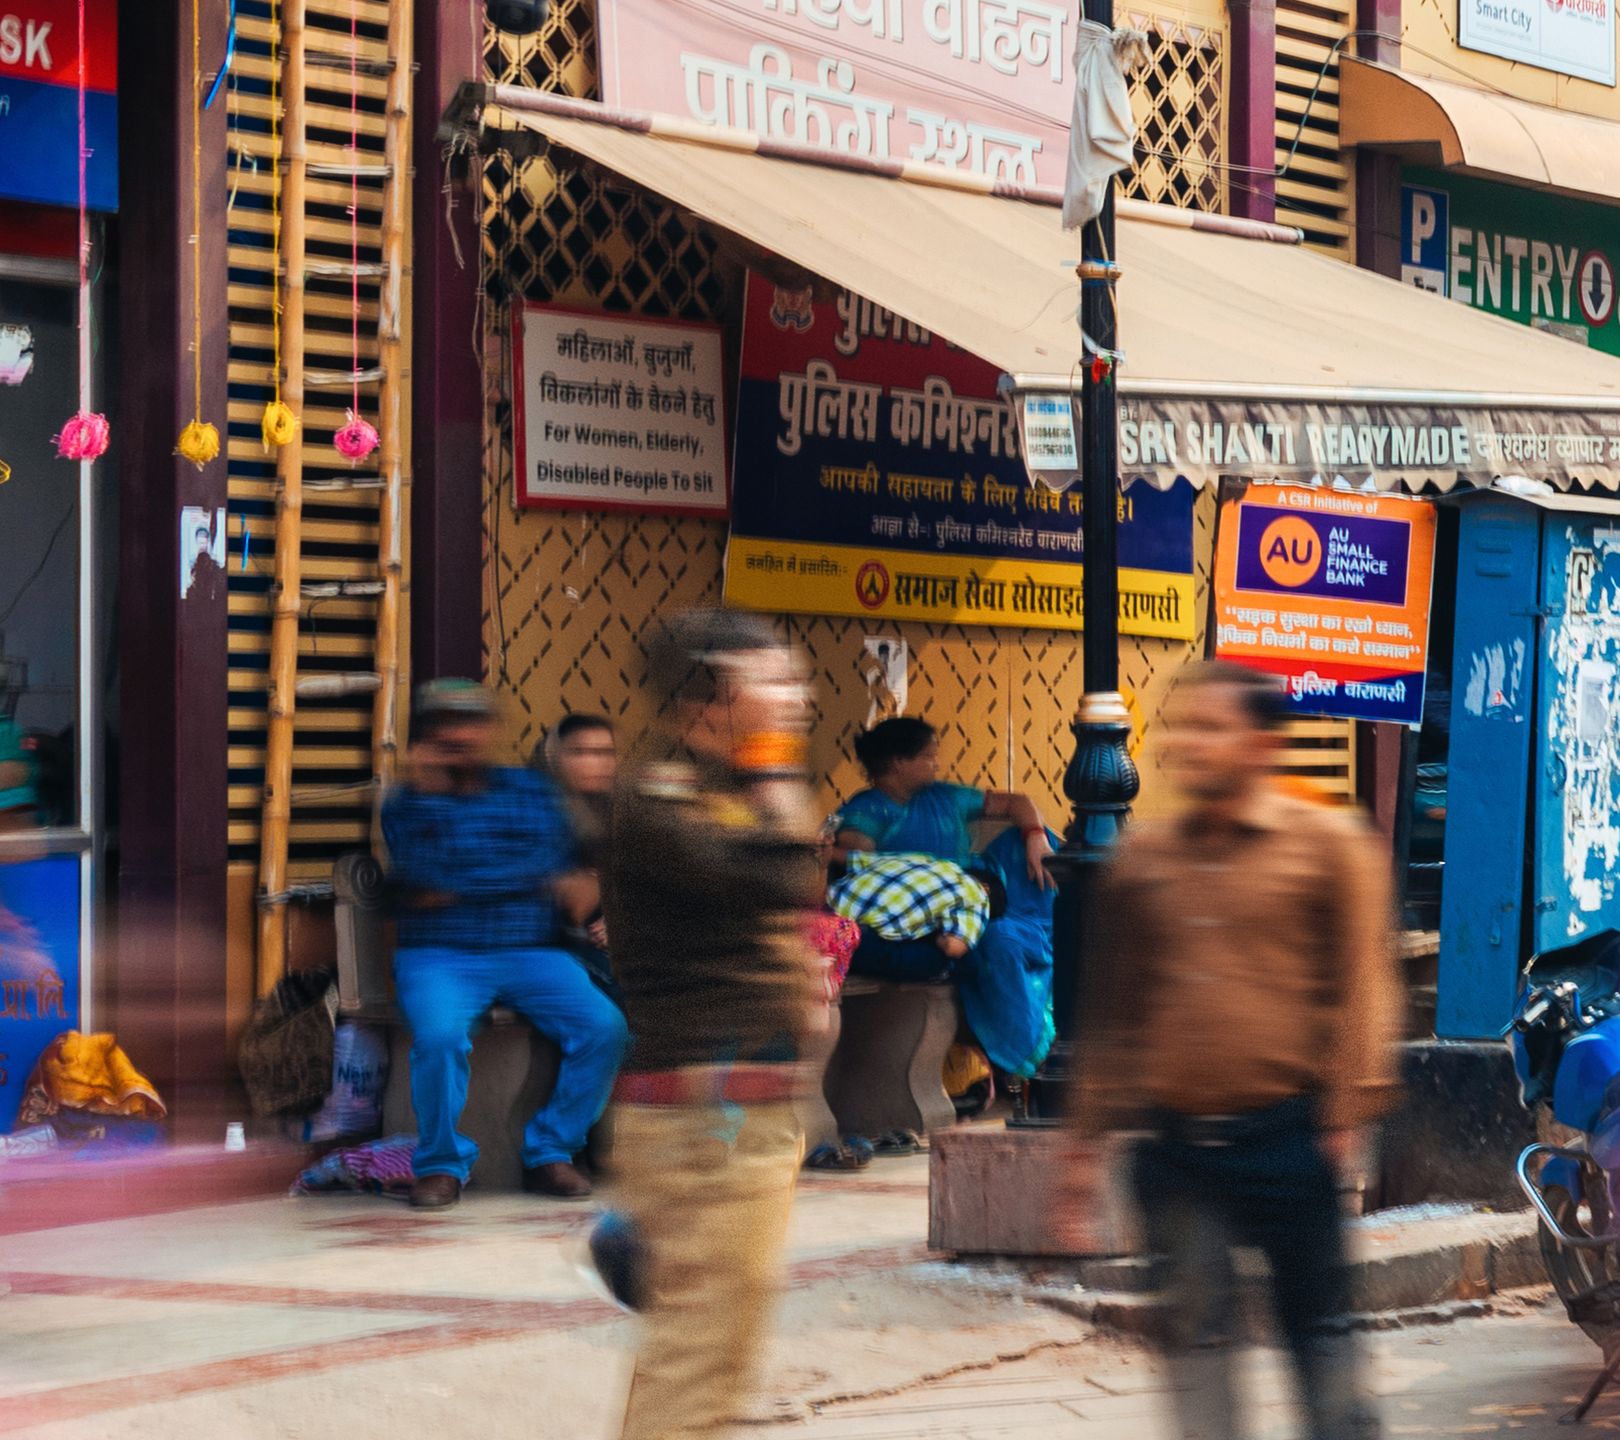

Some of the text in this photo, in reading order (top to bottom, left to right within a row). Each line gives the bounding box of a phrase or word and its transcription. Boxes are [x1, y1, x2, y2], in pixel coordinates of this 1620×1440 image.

[1511, 10, 1532, 32] City
[679, 42, 895, 160] पार्किंग
[1411, 191, 1436, 264] P
[1451, 226, 1580, 320] ENTRY
[557, 328, 640, 368] महिलाओं,
[625, 381, 643, 410] के
[778, 359, 883, 457] पुलिस
[545, 421, 704, 458] For Women, Elderly,
[1120, 421, 1178, 465] SRI
[1187, 421, 1297, 465] SHANTI
[1306, 422, 1471, 466] READYMADE
[1553, 435, 1604, 463] व्यापार
[537, 461, 714, 493] Disabled People To Sit
[820, 463, 1017, 515] आपकी सहायता के लिए
[1314, 493, 1364, 513] Initiative
[936, 519, 972, 549] पुलिस
[1329, 527, 1350, 542] AU
[1266, 535, 1314, 566] AU
[1327, 556, 1388, 576] FINANCE
[1329, 541, 1375, 561] SMALL
[894, 568, 1006, 615] समाज सेवा
[1326, 571, 1366, 588] BANK
[1321, 613, 1342, 630] का
[1309, 633, 1330, 652] का
[1291, 670, 1407, 704] पुलिस वाराणसी
